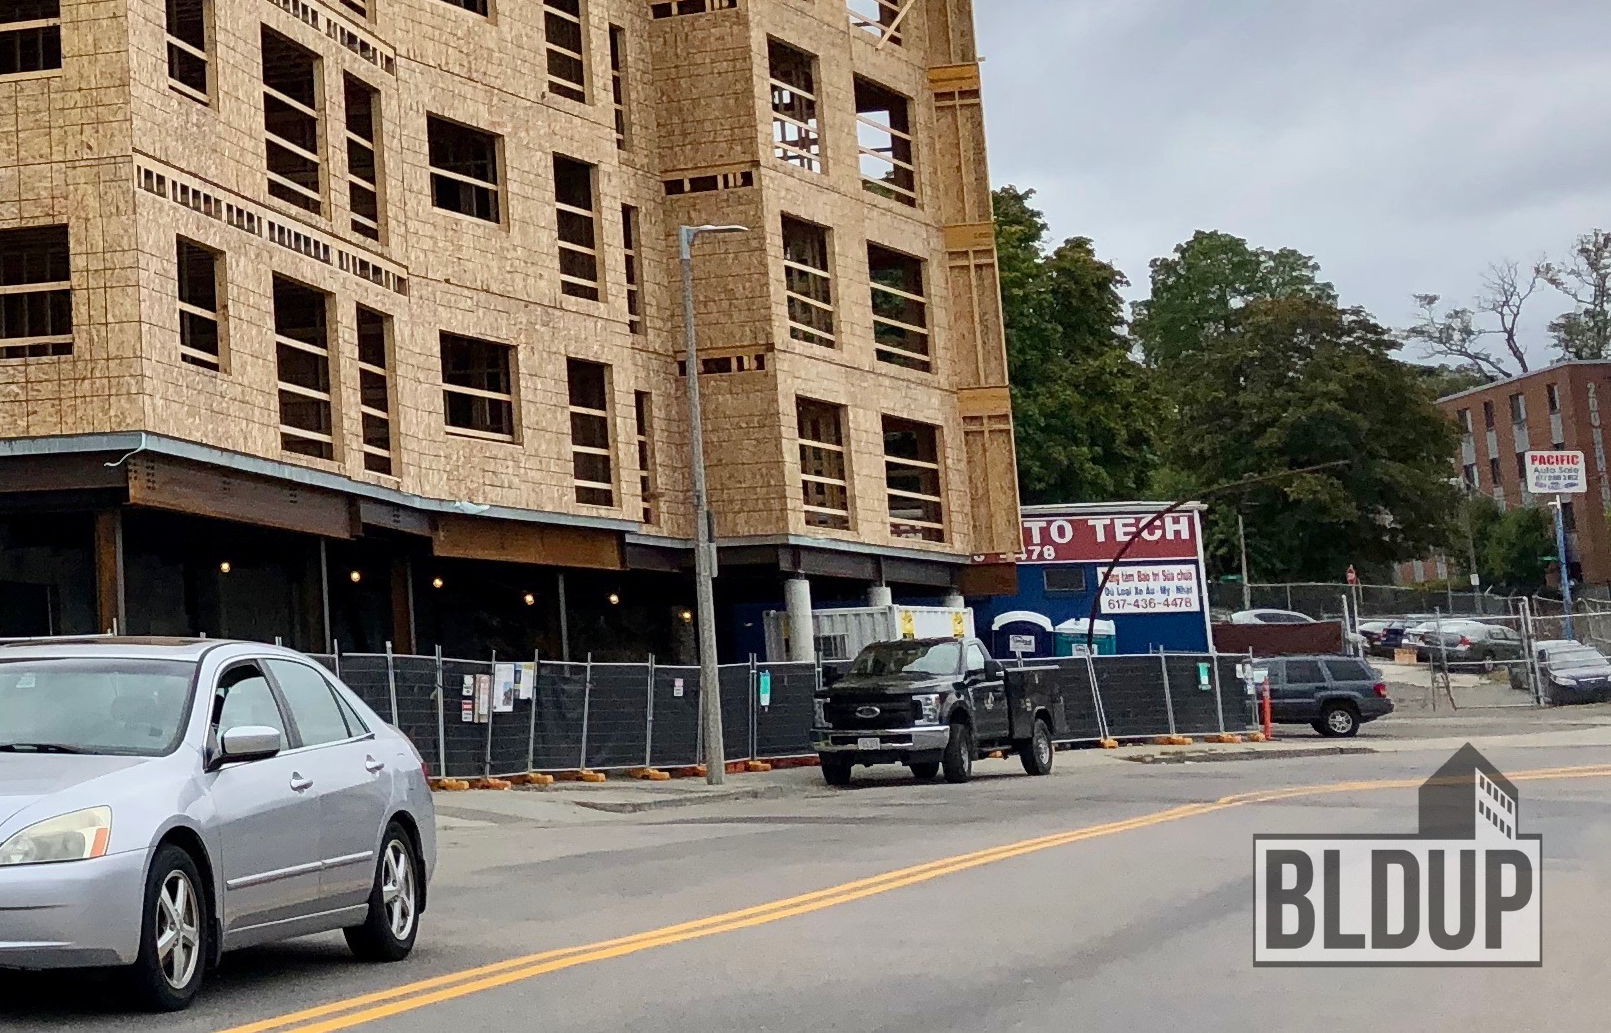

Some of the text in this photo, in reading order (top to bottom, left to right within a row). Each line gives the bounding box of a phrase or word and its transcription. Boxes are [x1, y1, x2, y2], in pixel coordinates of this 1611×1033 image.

[1530, 454, 1580, 466] PACIFIC
[1534, 466, 1556, 474] Auto
[1088, 516, 1190, 543] TECH
[1107, 597, 1193, 610] 617-436-4478
